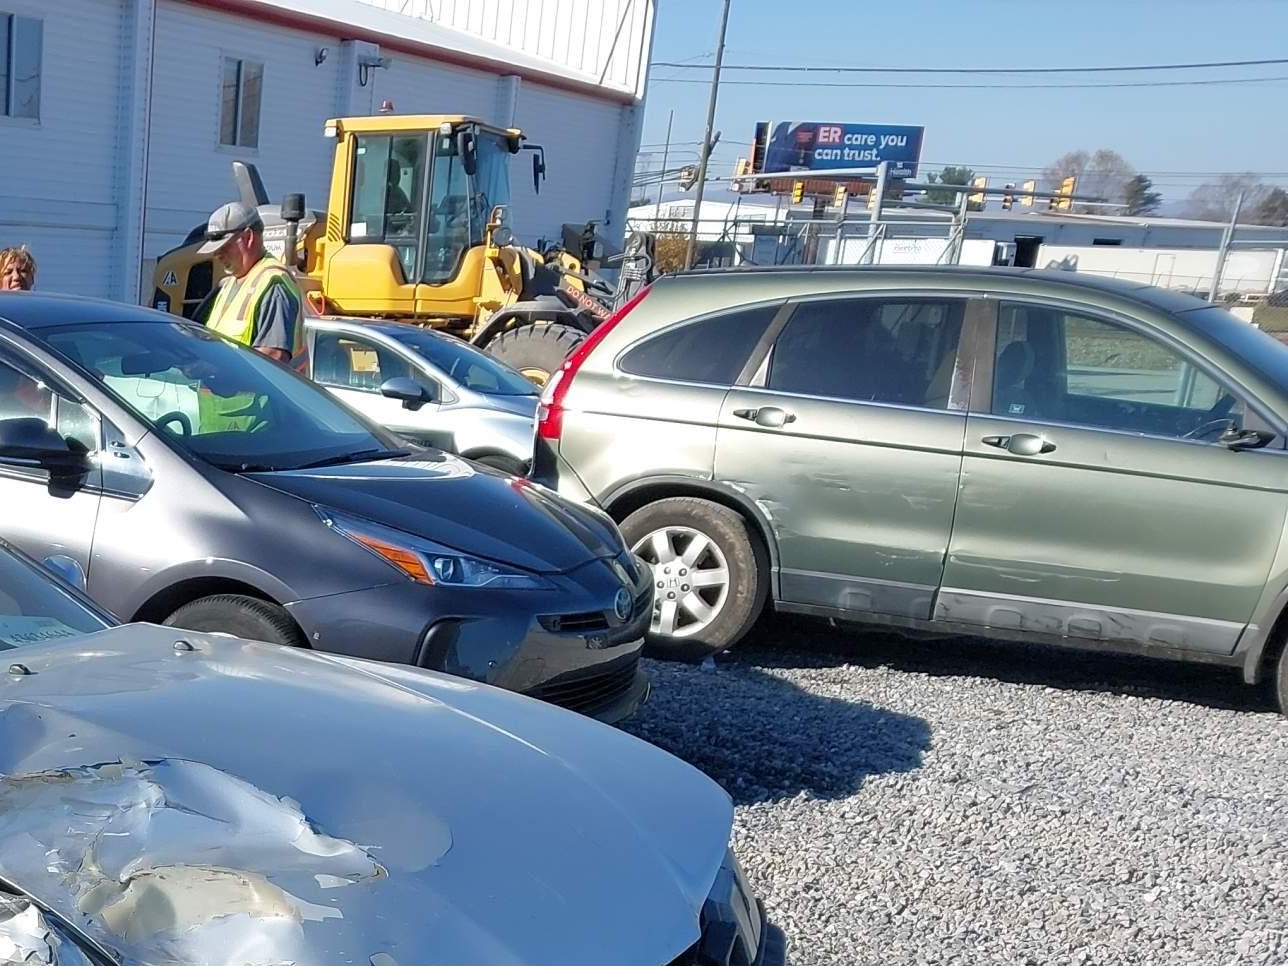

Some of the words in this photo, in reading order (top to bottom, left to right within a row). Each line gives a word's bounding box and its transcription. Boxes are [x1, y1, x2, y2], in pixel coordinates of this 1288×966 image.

[818, 126, 842, 143] ER
[843, 133, 876, 146] care
[879, 135, 907, 149] you
[814, 148, 841, 160] can
[843, 149, 881, 161] trust.
[566, 286, 580, 298] DO
[578, 295, 597, 311] NOT
